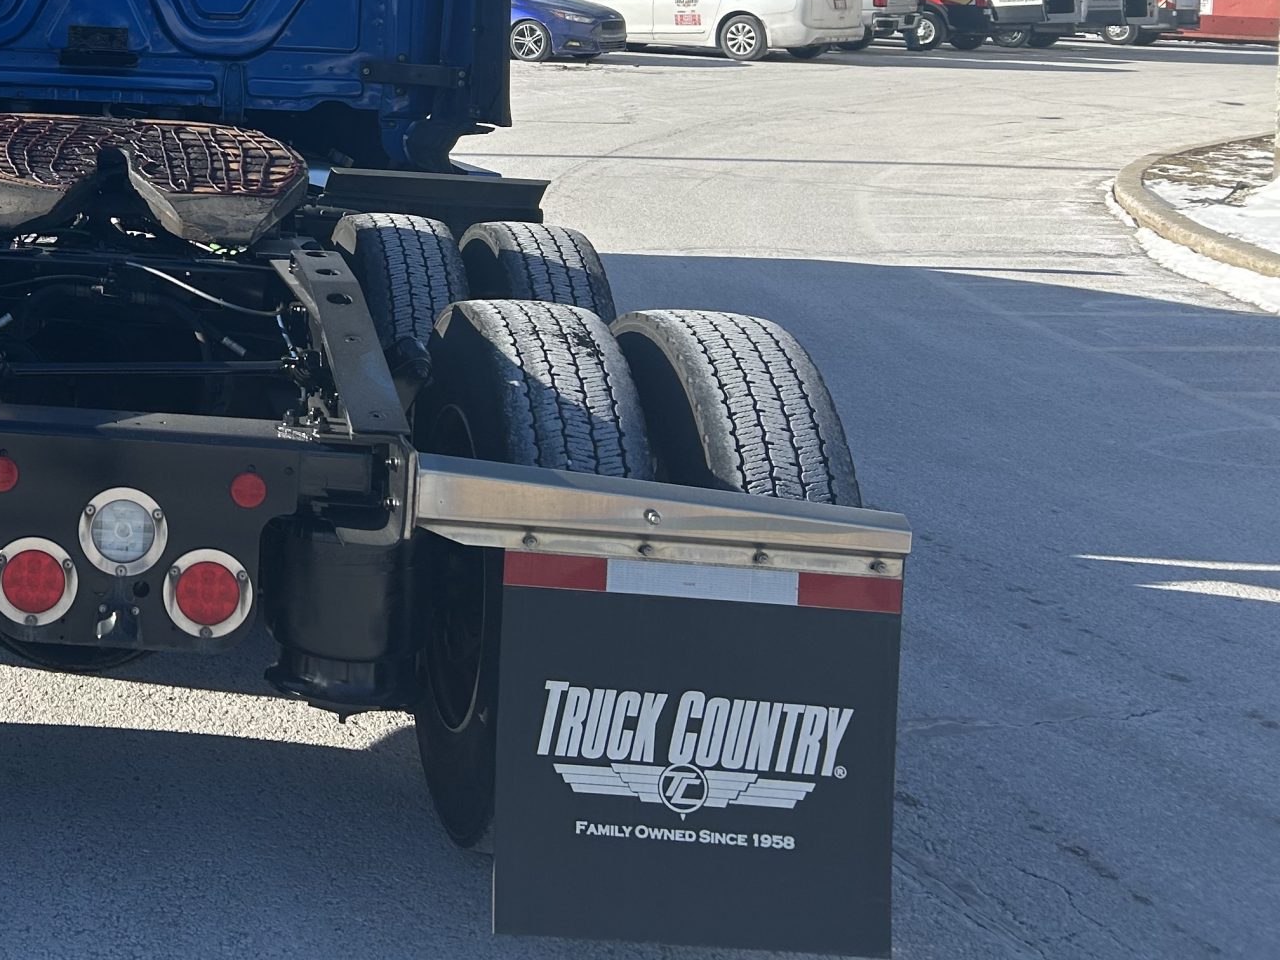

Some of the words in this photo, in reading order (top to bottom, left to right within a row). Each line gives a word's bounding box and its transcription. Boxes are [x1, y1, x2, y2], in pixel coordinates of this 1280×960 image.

[537, 679, 668, 763] TRUCK
[575, 820, 632, 838] FAMILY
[634, 823, 697, 844] OWNED
[698, 827, 748, 847] SINCE
[751, 831, 796, 850] 1958
